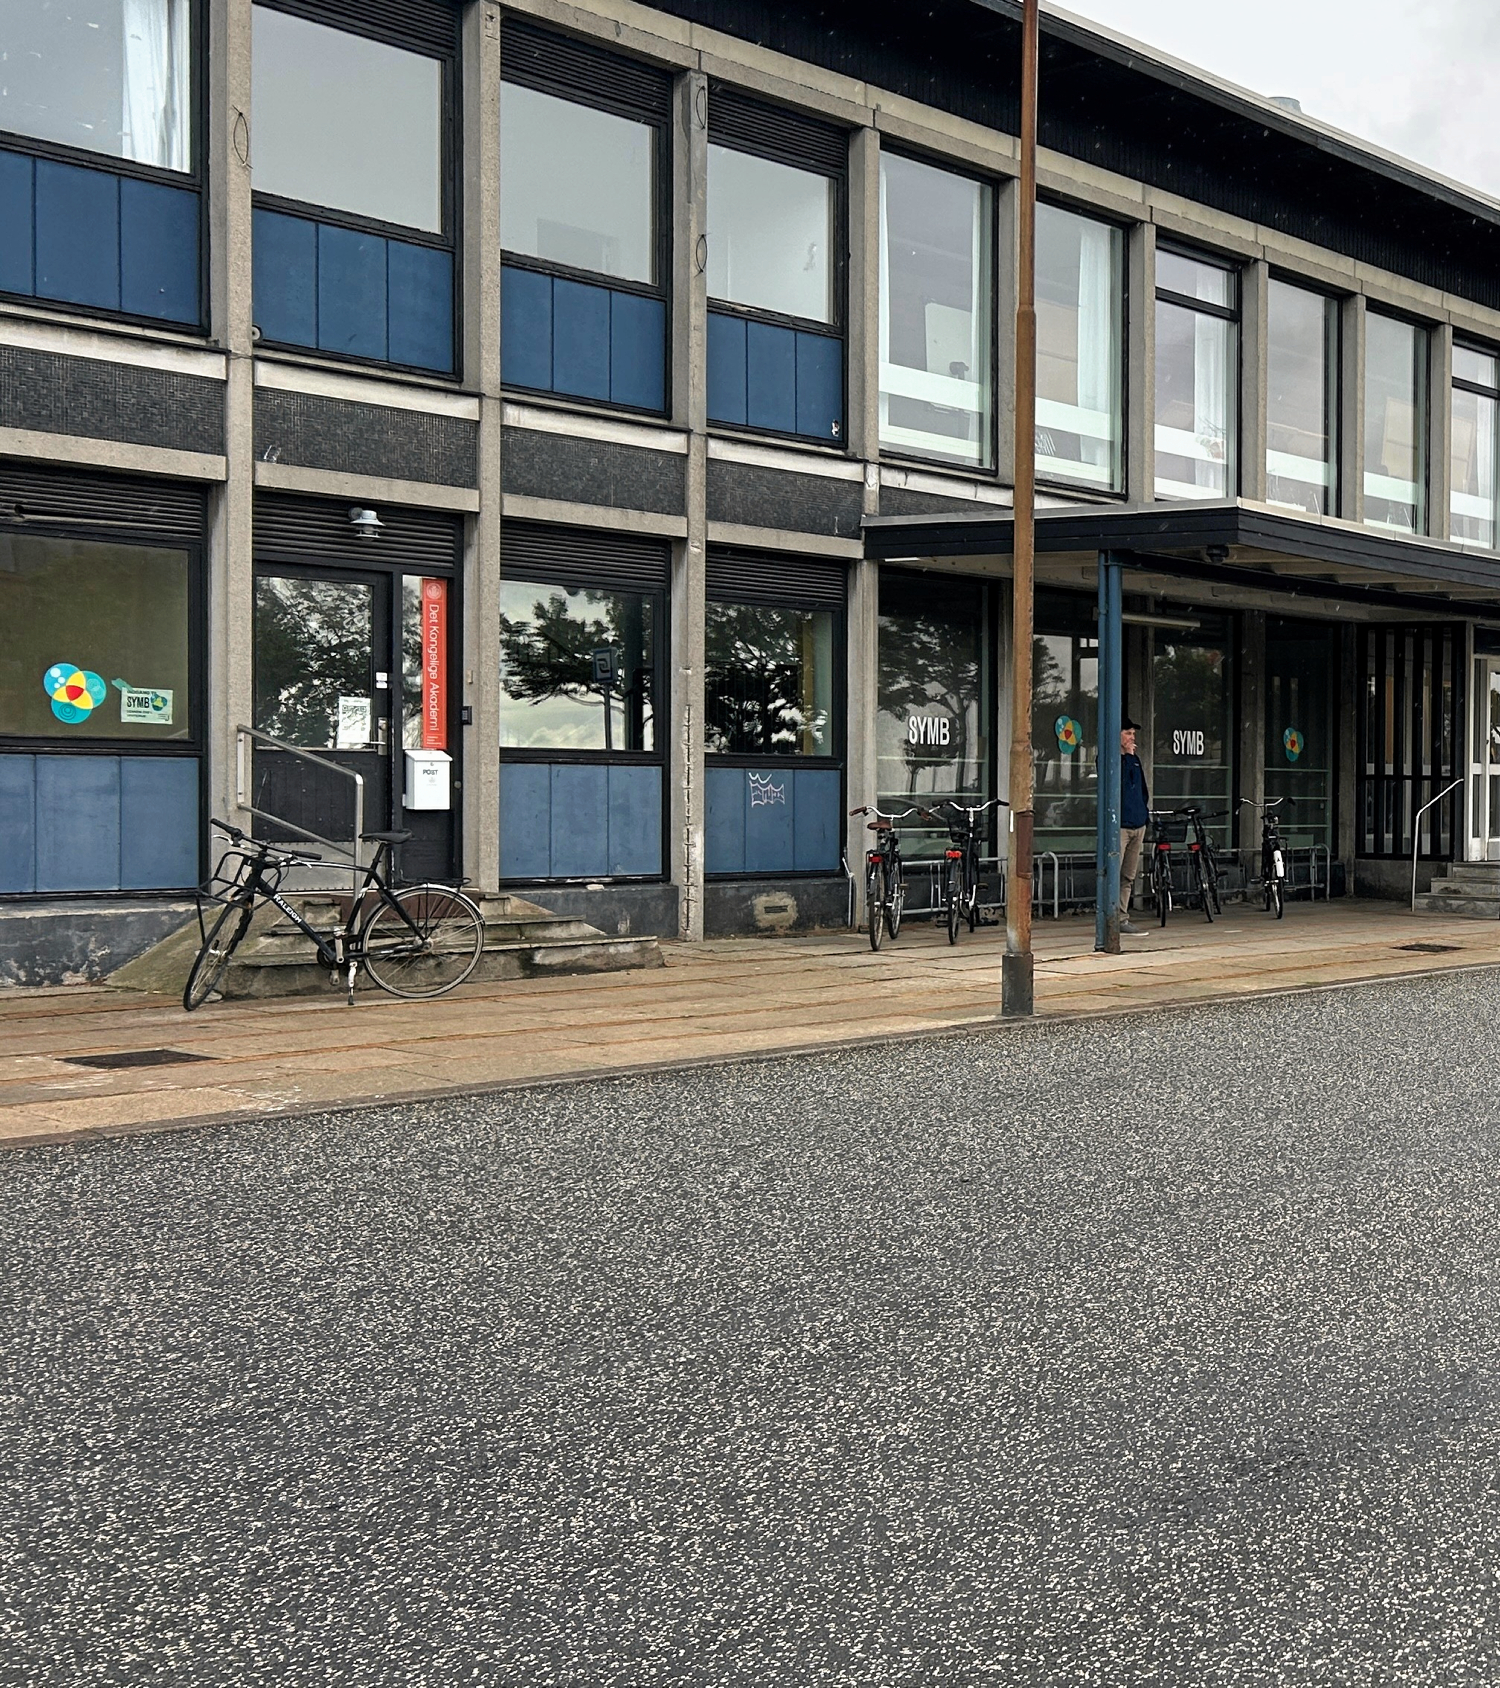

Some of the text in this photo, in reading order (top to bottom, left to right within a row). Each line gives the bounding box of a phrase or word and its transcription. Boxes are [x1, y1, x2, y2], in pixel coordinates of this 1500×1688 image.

[429, 604, 440, 623] Det
[427, 625, 440, 680] Kongelige
[127, 696, 150, 708] SYMB
[429, 682, 440, 731] Akademi
[909, 715, 950, 745] SYMB
[1173, 729, 1204, 755] SYMB
